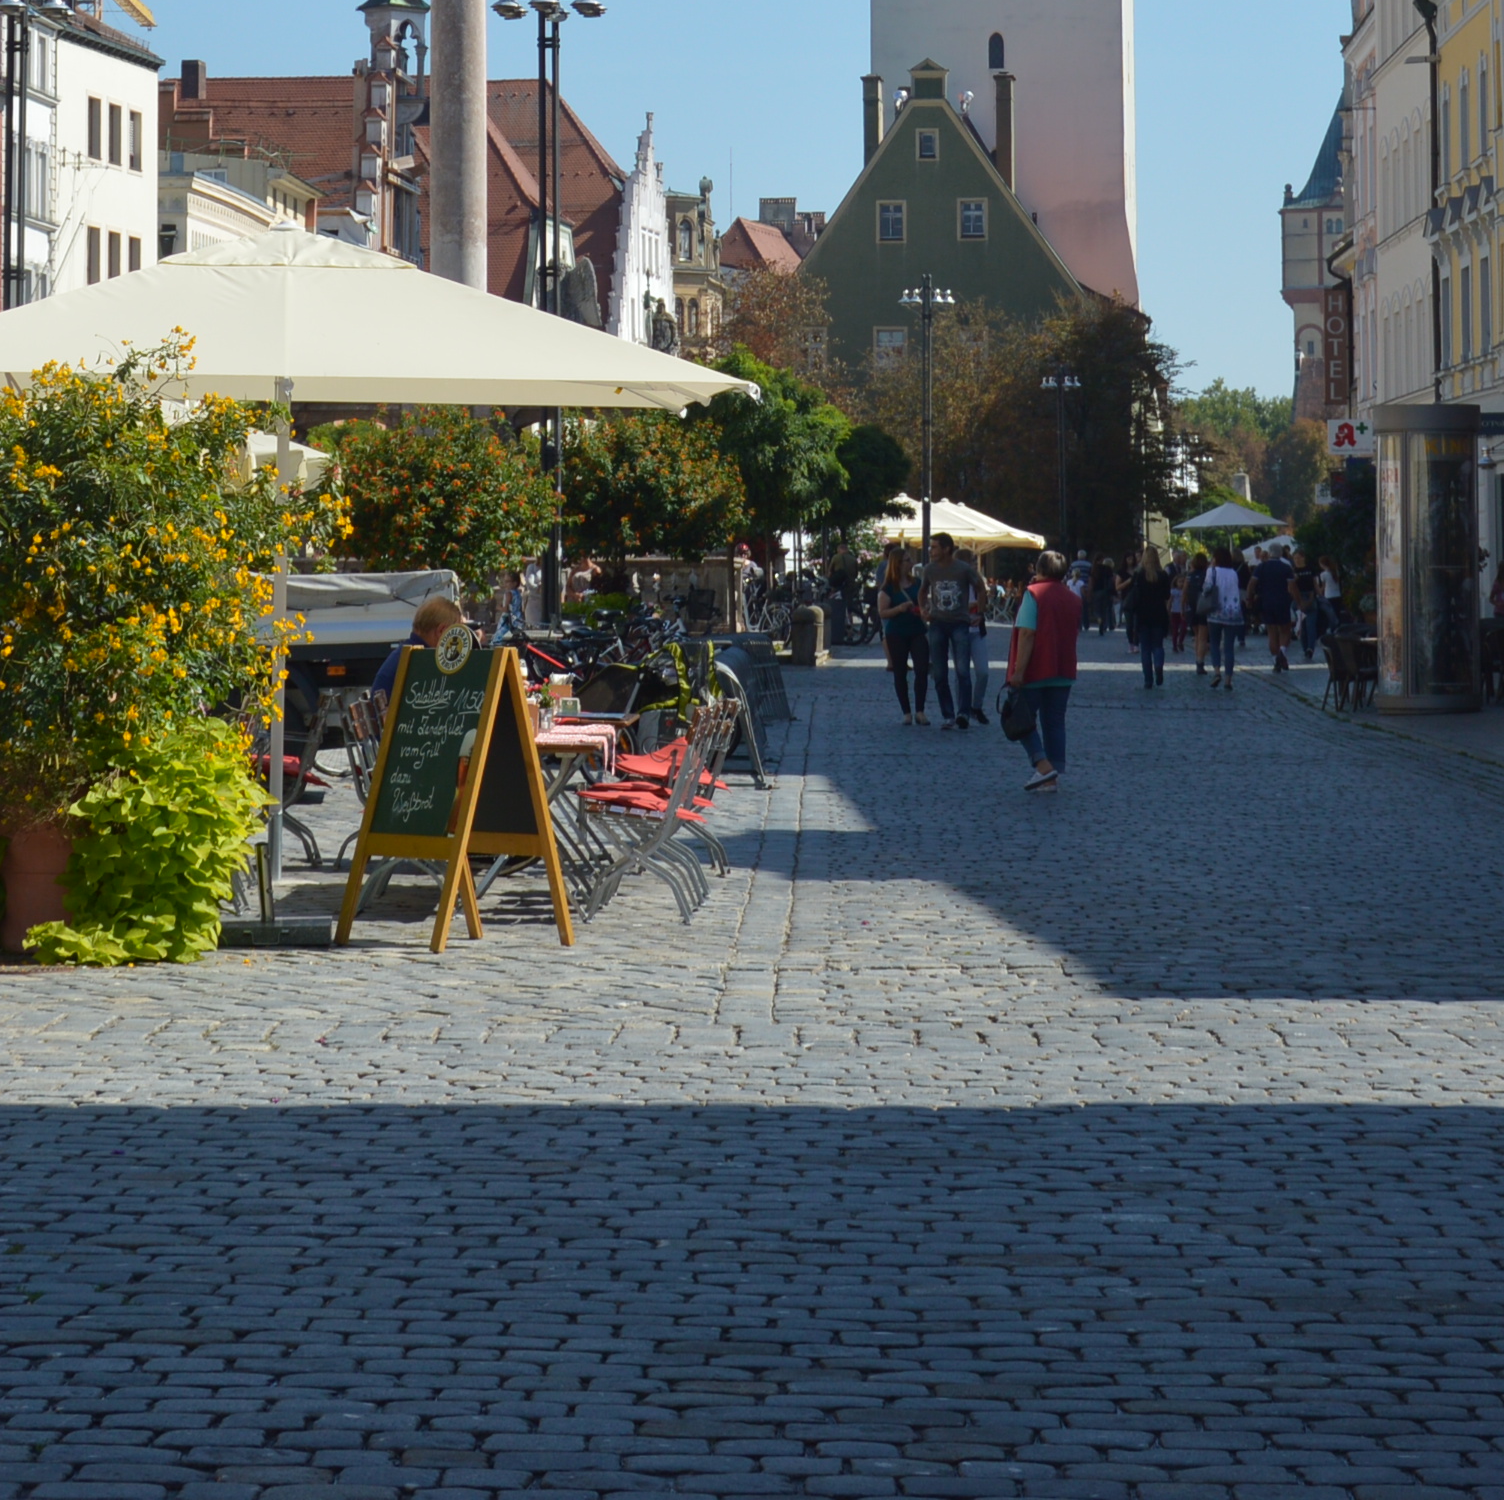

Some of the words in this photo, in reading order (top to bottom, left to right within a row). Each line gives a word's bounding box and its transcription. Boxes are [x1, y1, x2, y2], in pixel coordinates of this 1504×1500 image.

[1326, 294, 1345, 401] HOTEL
[397, 717, 414, 736] mit
[400, 745, 420, 758] vom
[413, 742, 441, 770] Grill
[390, 766, 412, 784] dazu
